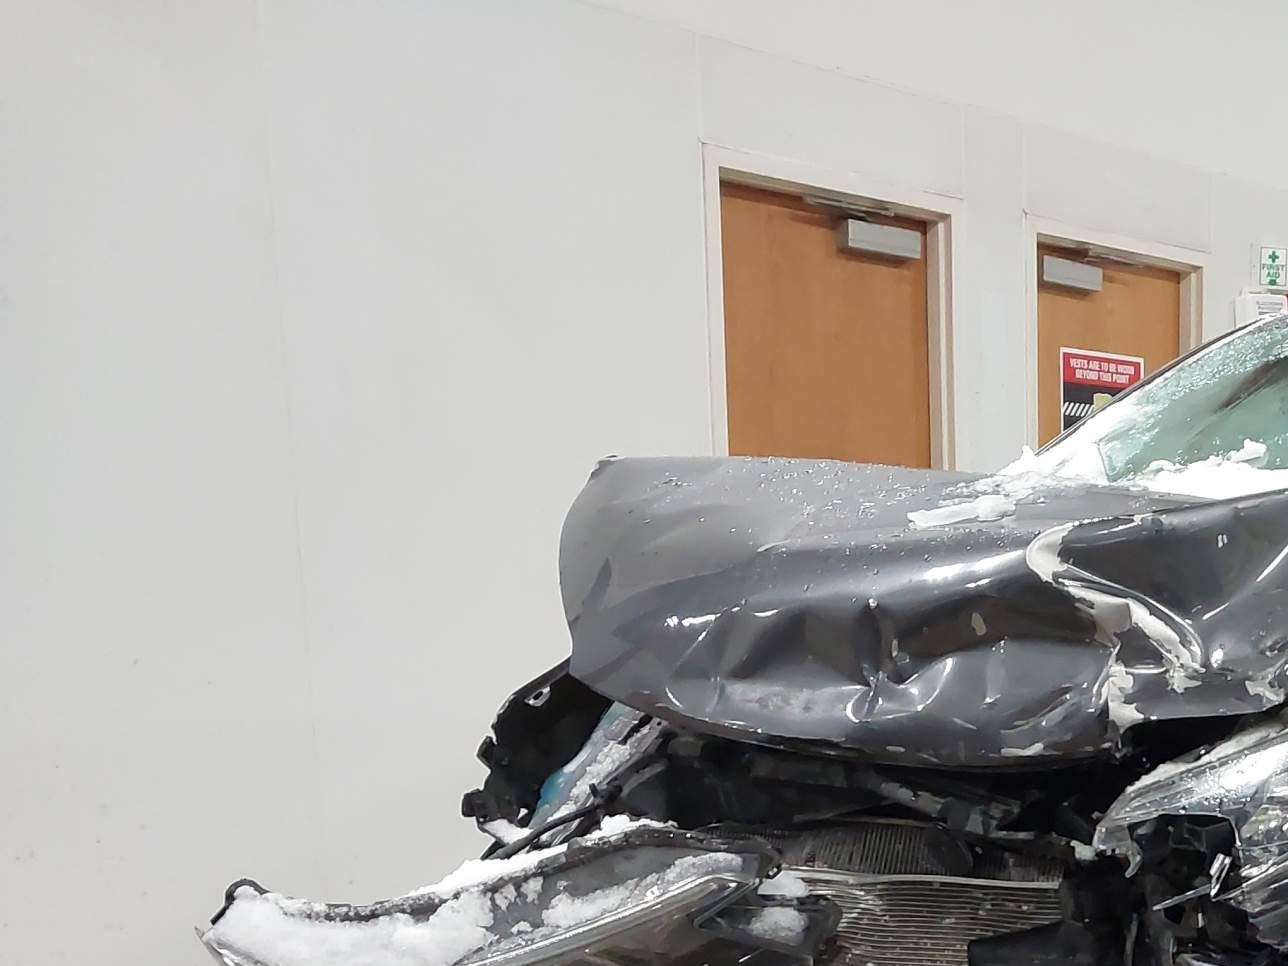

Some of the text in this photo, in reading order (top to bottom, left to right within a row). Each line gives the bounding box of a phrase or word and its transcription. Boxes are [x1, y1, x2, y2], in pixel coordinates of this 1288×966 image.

[1262, 263, 1285, 271] FIRST
[1265, 271, 1281, 279] AID
[1069, 357, 1135, 375] VESTS ARE TO BE WORN
[1075, 368, 1130, 384] BEYOND THIS POINT
